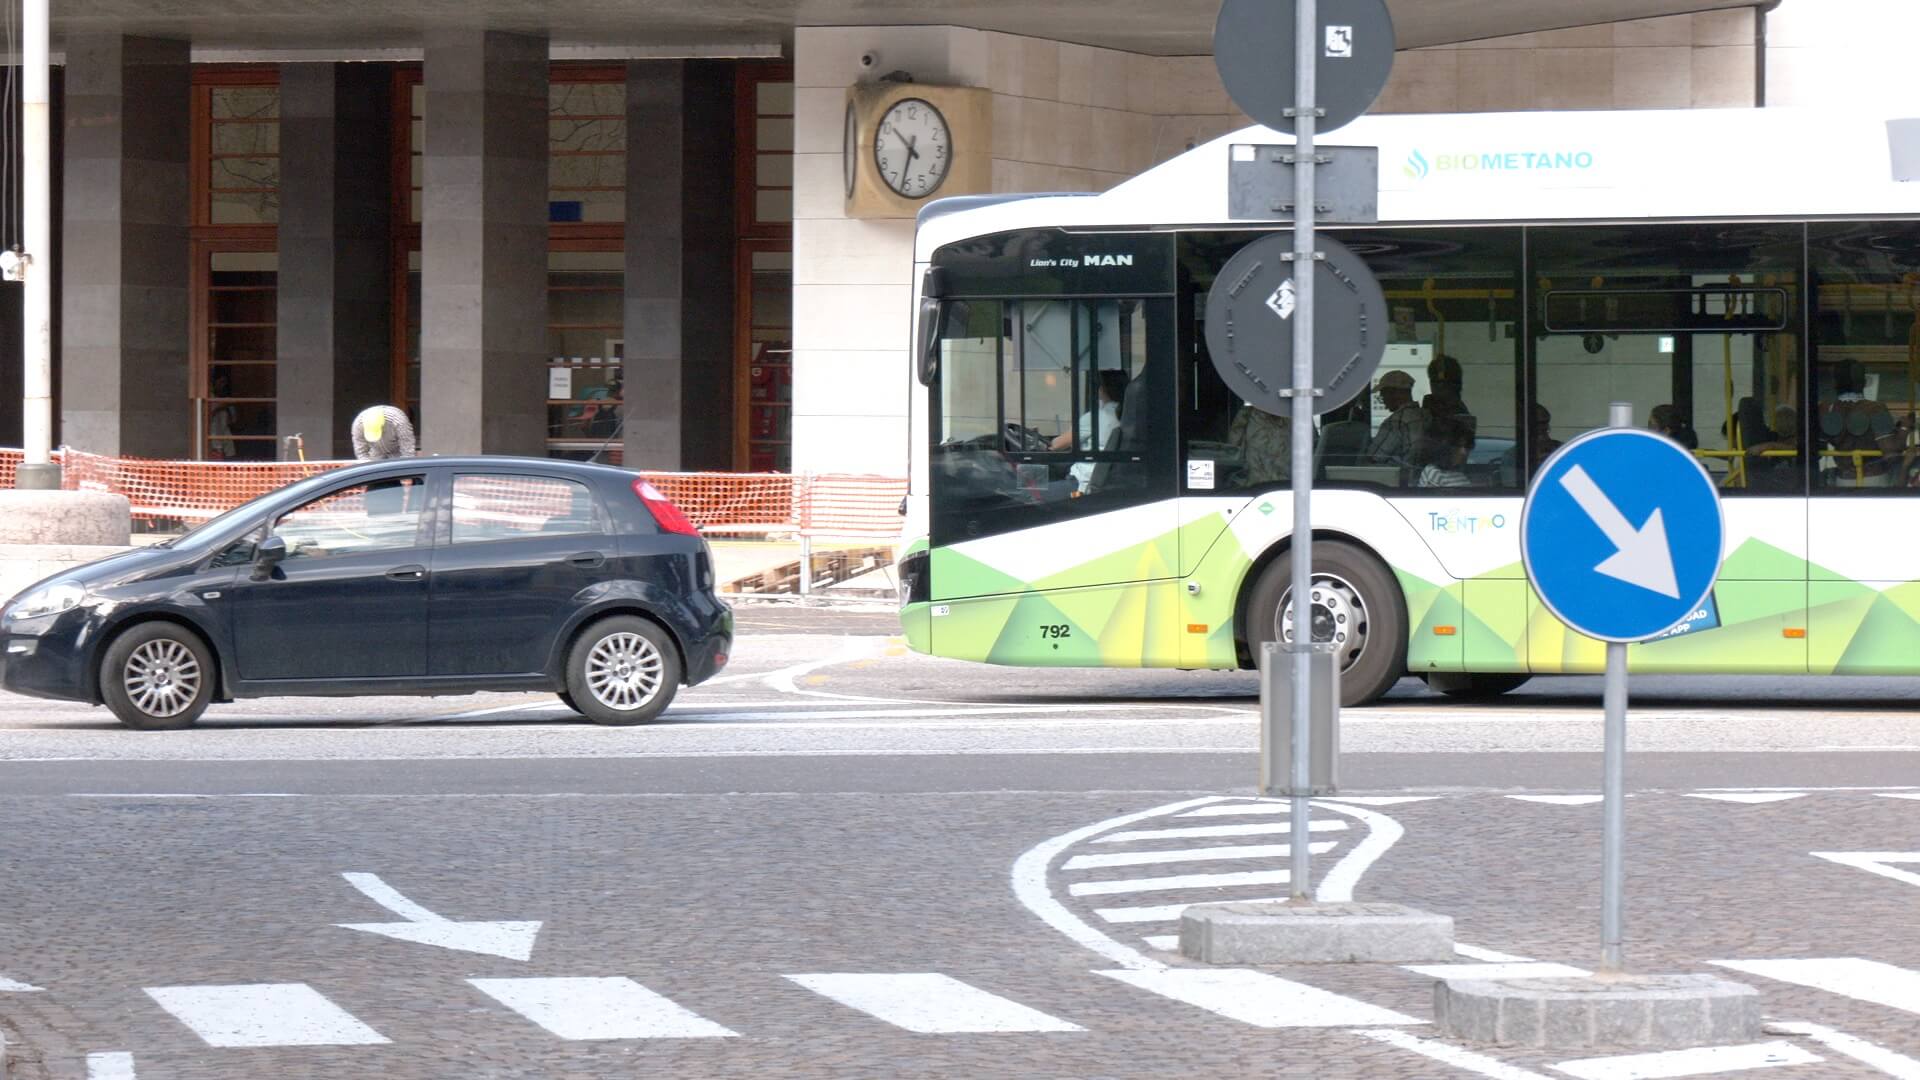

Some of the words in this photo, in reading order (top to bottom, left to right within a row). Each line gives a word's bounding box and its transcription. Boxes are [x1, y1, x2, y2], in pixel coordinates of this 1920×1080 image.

[907, 106, 917, 120] 12
[936, 145, 944, 159] 3
[881, 157, 888, 171] 8
[1436, 151, 1593, 171] BIOMETANO
[1030, 258, 1057, 267] Lion's
[1060, 258, 1079, 268] City
[1084, 254, 1133, 266] MAN
[1039, 624, 1071, 639] 792
